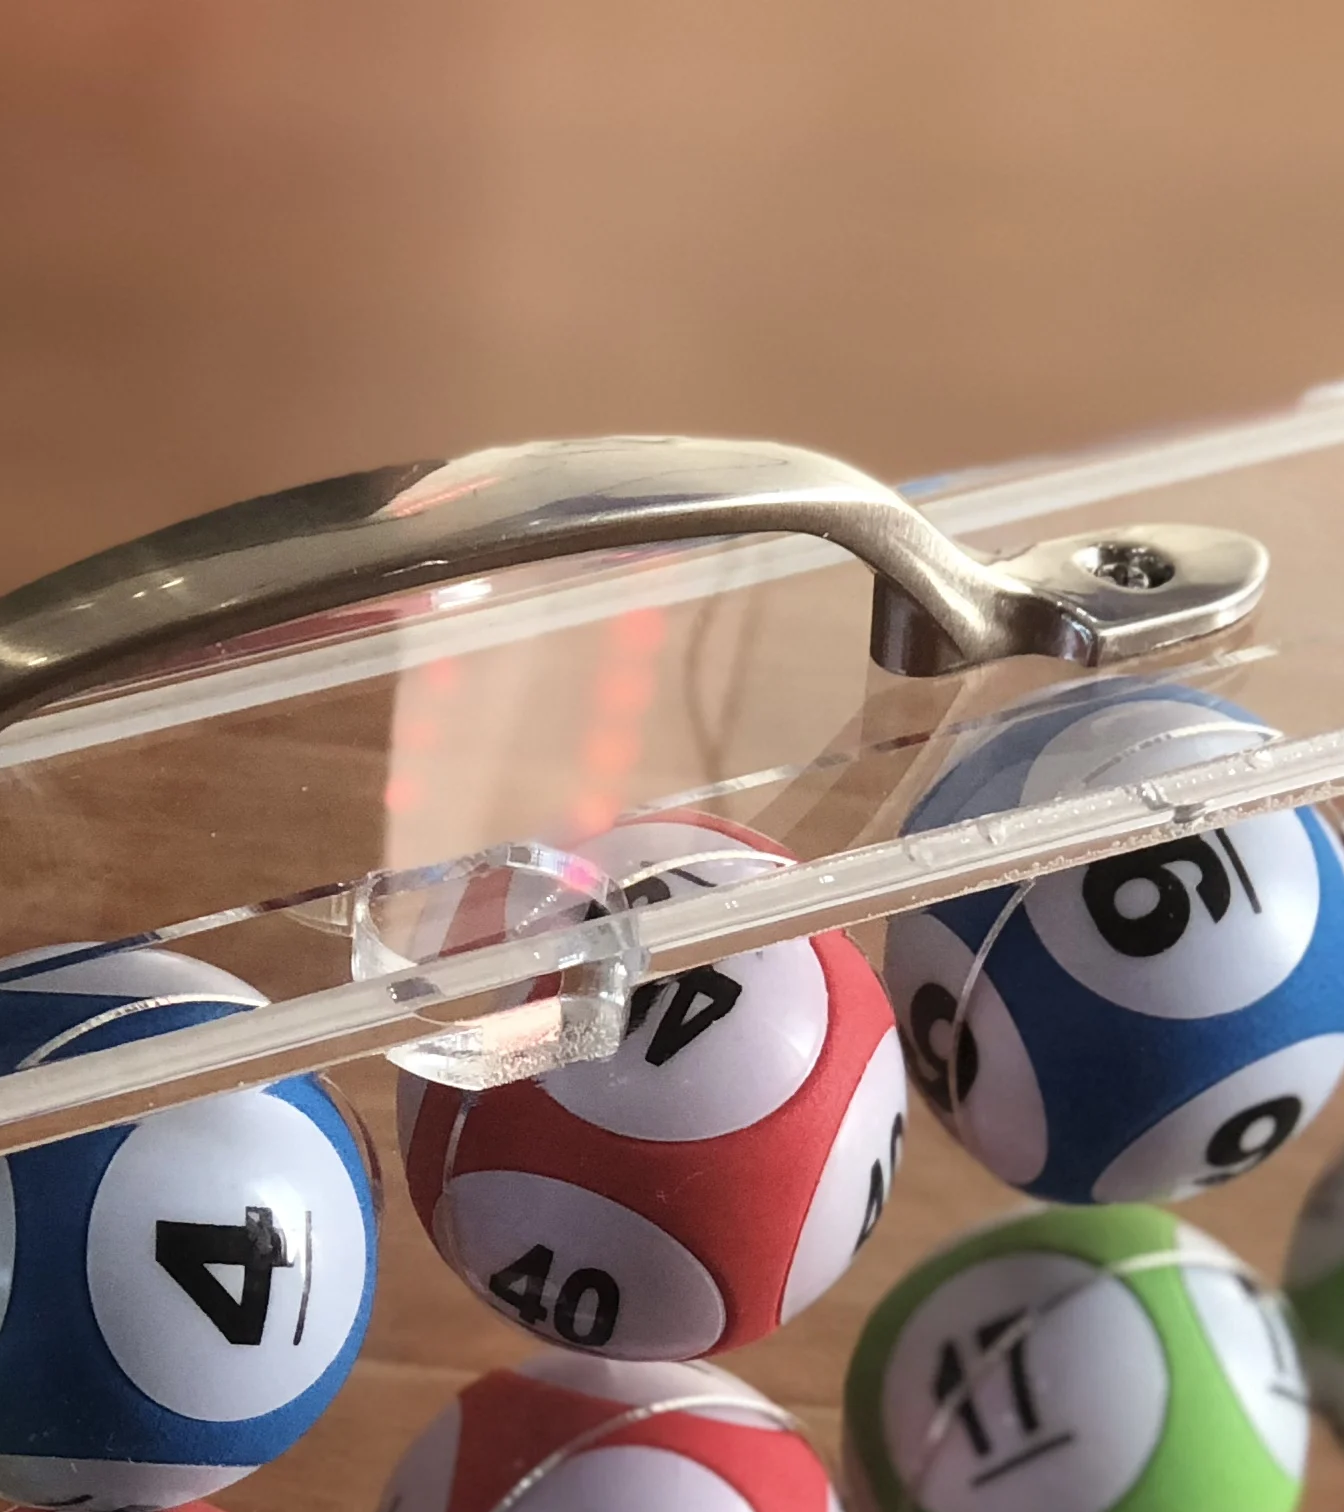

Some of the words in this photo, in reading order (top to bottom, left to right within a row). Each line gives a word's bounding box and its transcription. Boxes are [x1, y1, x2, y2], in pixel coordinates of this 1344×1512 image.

[156, 1206, 295, 1346] 4
[489, 1244, 621, 1347] 40
[934, 1305, 1040, 1460] 17
